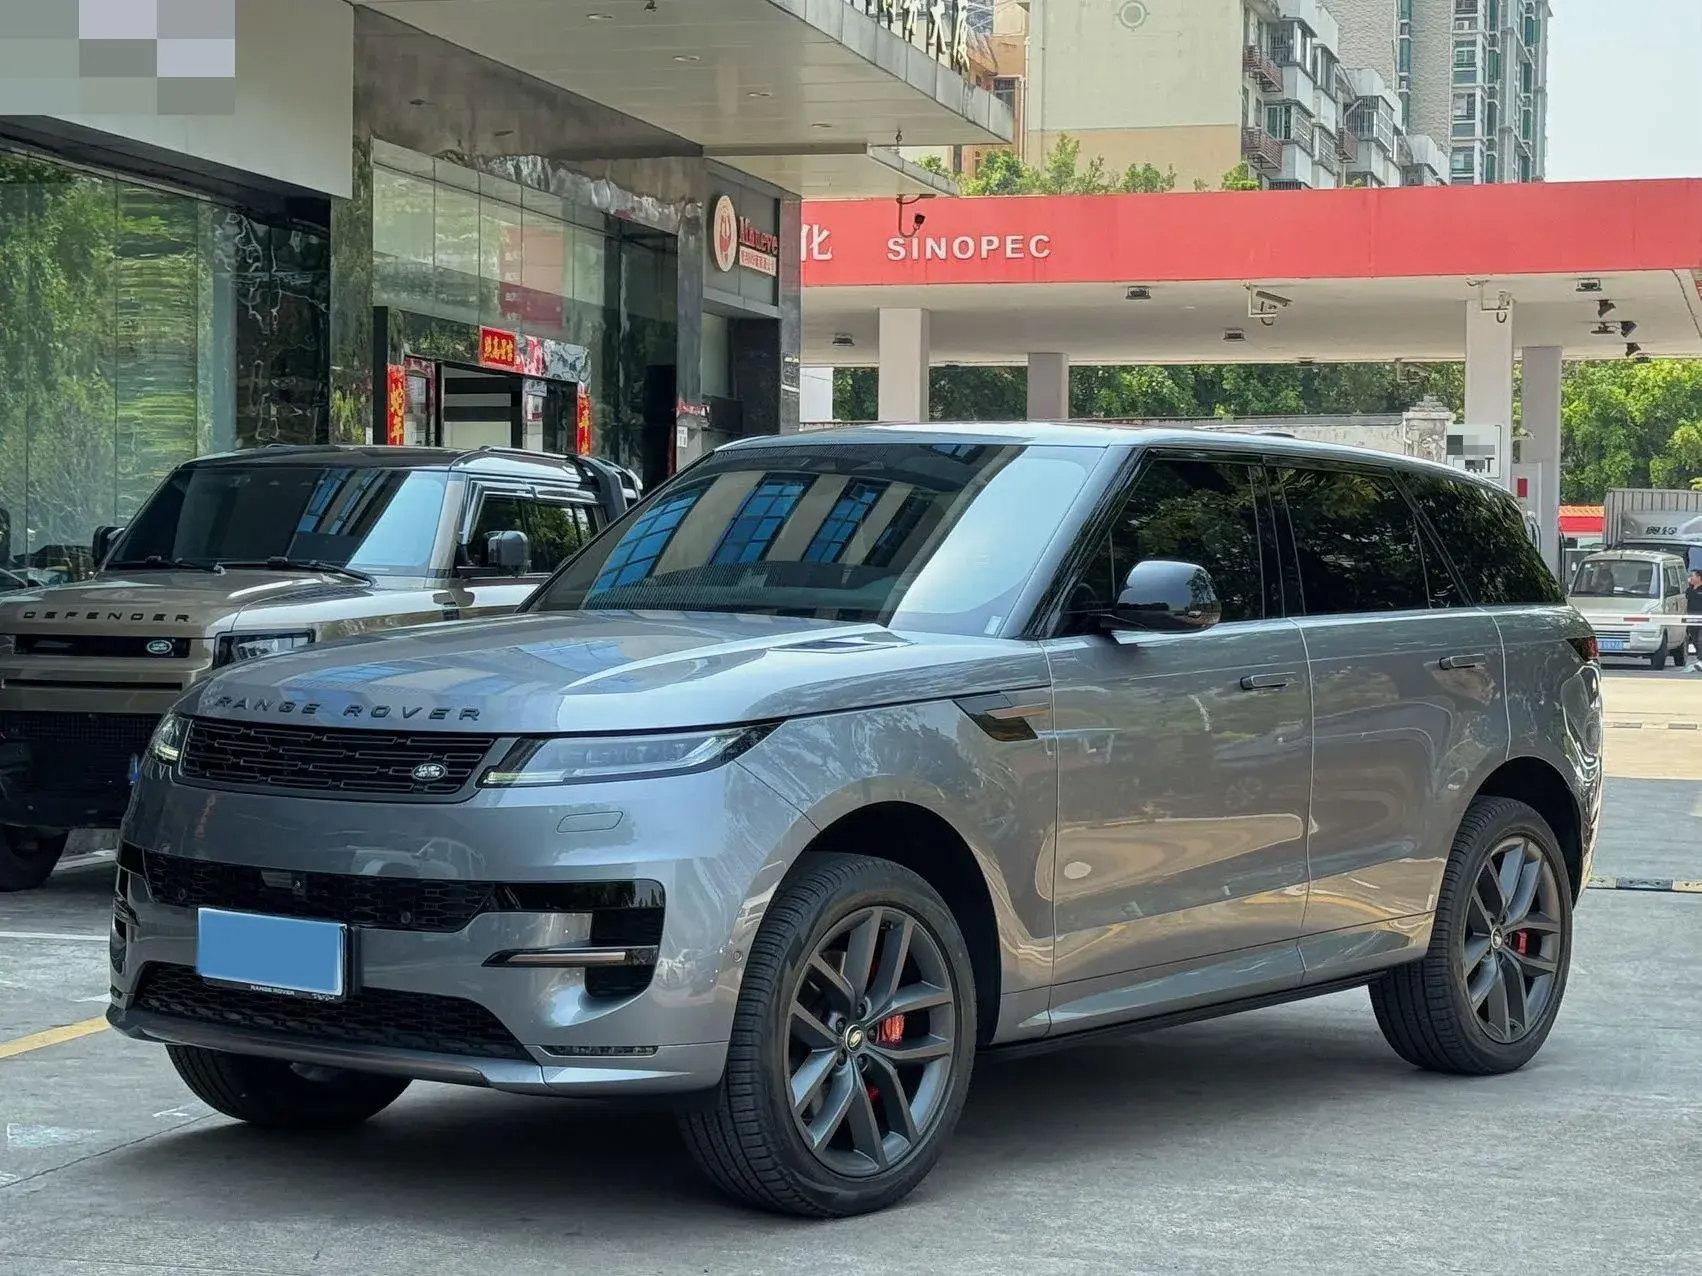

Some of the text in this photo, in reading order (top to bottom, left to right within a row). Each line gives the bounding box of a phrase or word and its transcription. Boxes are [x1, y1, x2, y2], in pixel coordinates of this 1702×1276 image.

[887, 234, 1051, 261] SINOPEC
[23, 611, 190, 622] DEFENDER
[214, 695, 481, 722] RANGE ROVER
